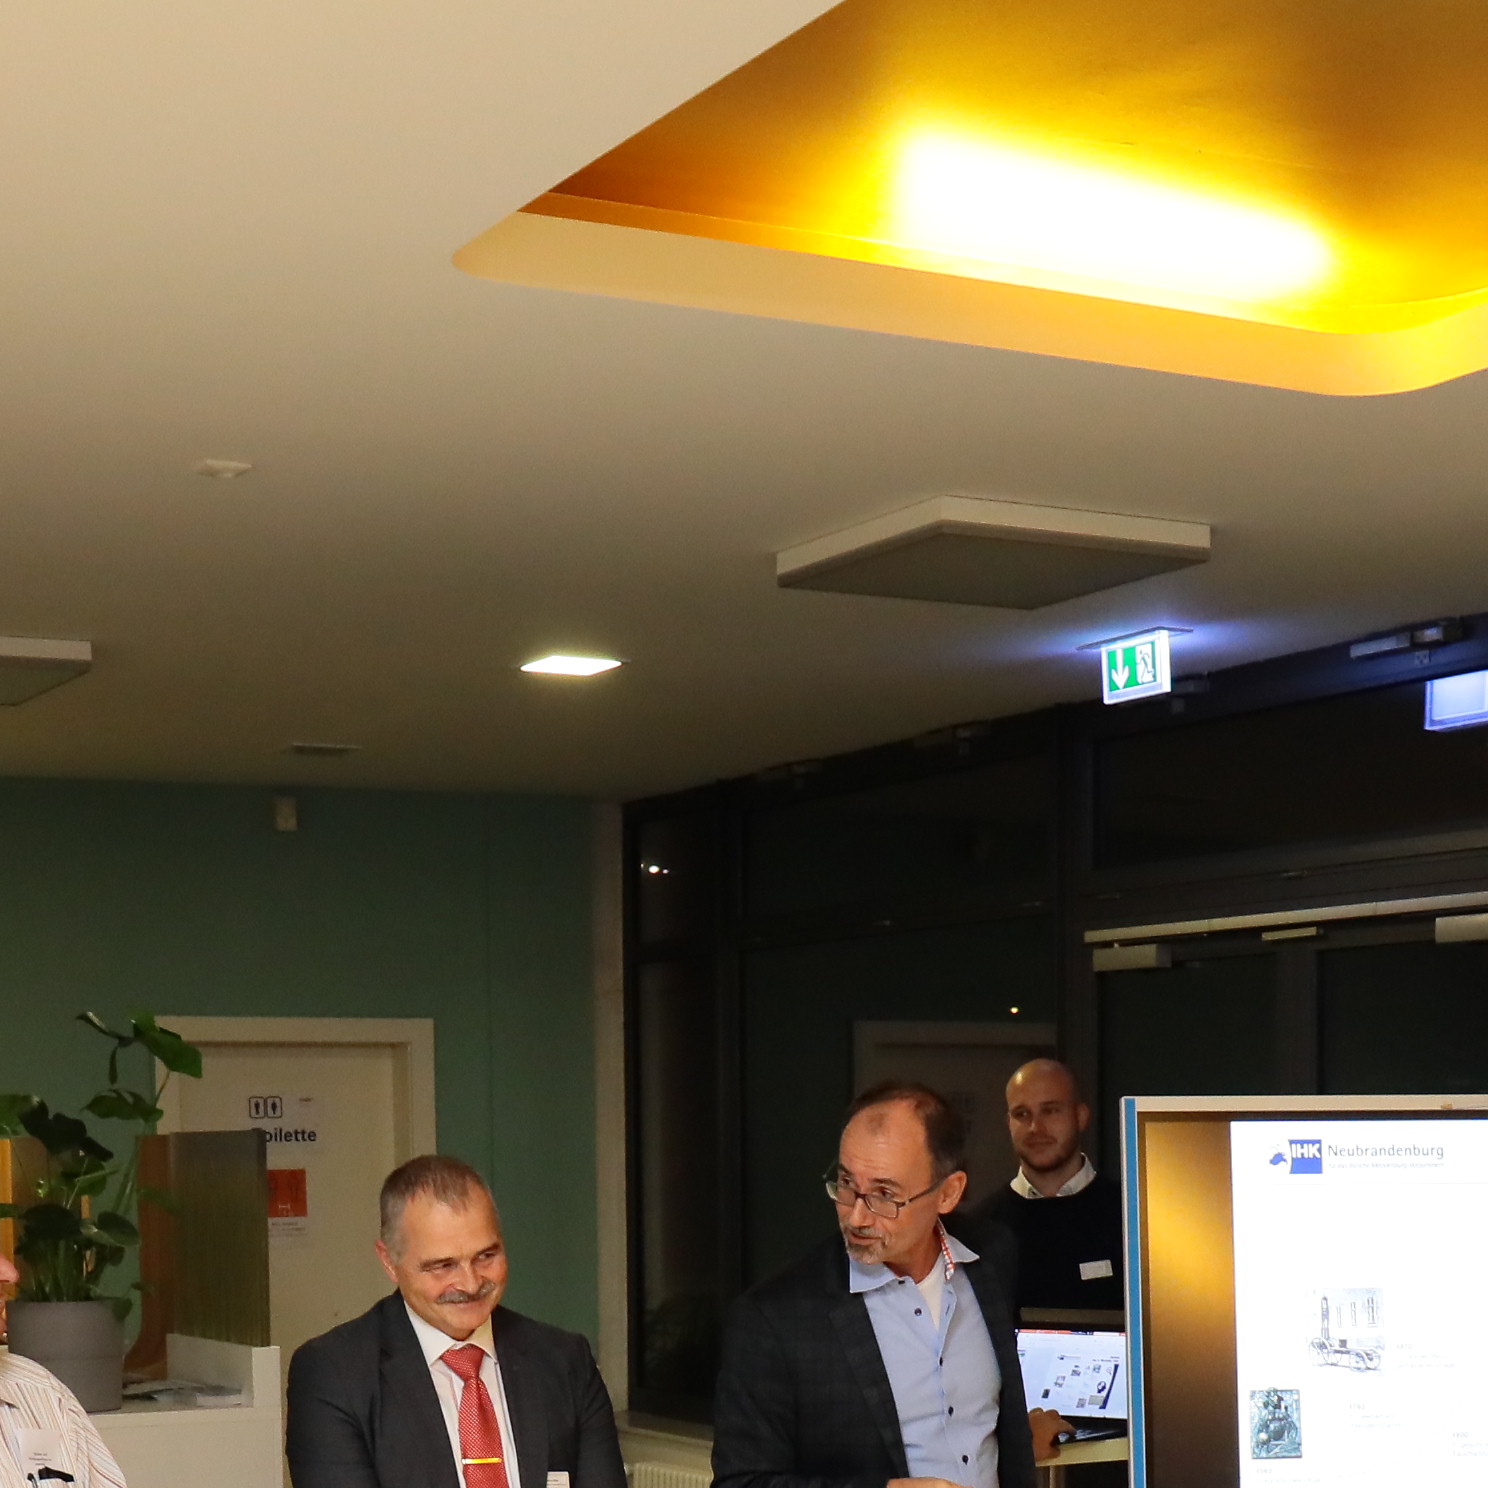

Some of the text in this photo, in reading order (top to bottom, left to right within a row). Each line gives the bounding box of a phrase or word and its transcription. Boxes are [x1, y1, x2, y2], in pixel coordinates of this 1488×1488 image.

[255, 1127, 317, 1143] oilette
[1291, 1143, 1445, 1160] IHK Neubrandenburg
